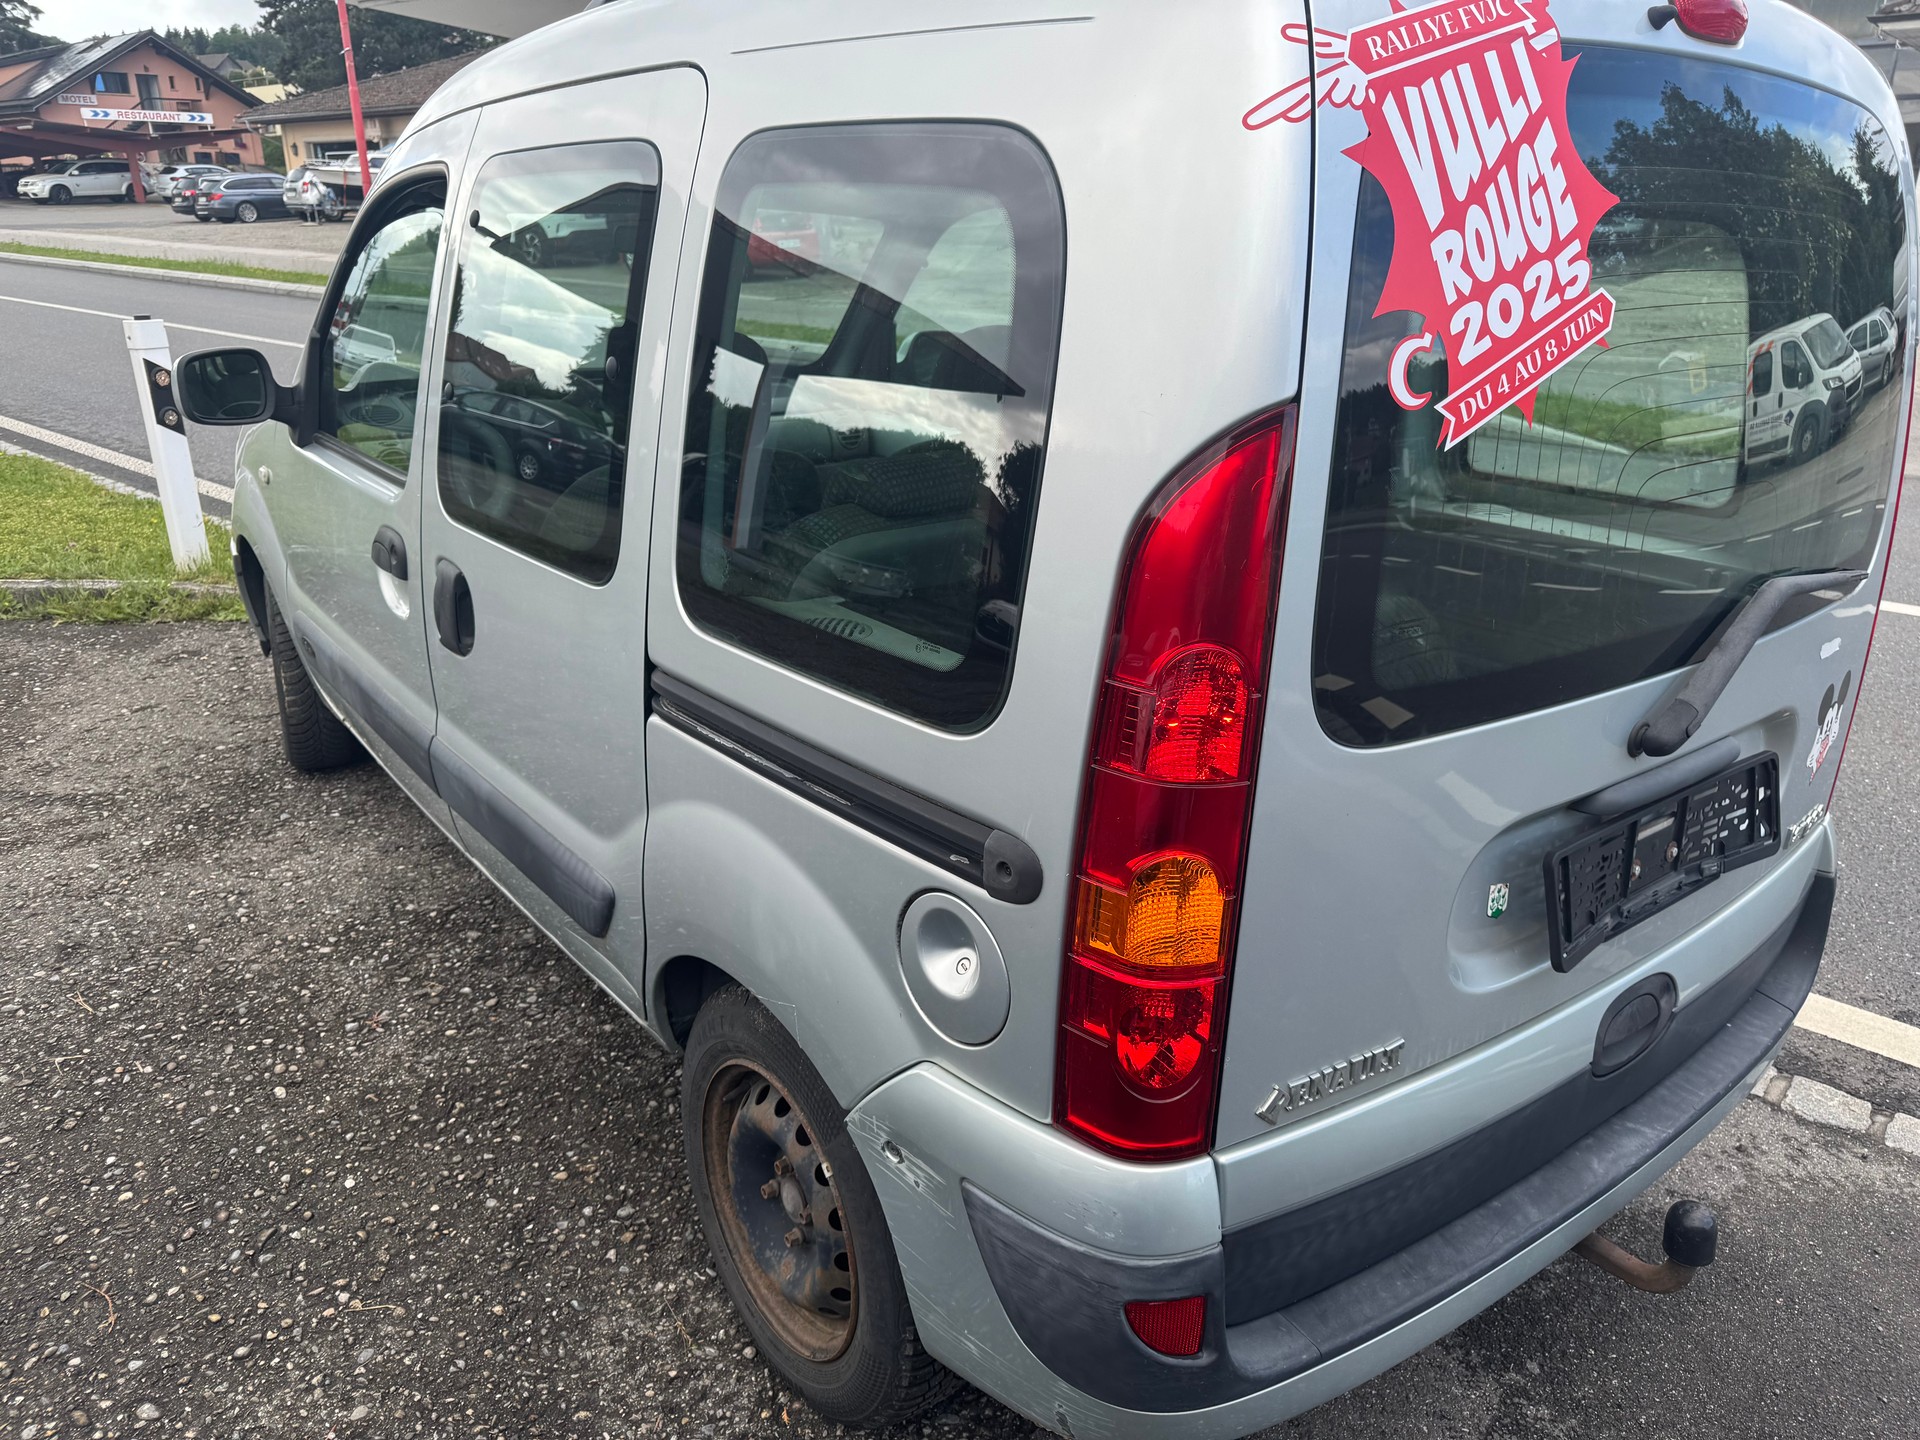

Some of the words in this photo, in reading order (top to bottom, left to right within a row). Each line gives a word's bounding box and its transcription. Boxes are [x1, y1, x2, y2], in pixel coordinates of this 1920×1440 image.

[1365, 11, 1459, 62] RALLYE
[1457, 0, 1513, 30] FVJC
[61, 94, 96, 105] MOTEL
[116, 110, 181, 122] RESTAURANT
[1381, 36, 1543, 233] VULLI
[1430, 116, 1579, 306] ROUGE
[1449, 238, 1590, 367] 2025
[1458, 383, 1494, 424] DU
[1497, 373, 1511, 395] 4
[1514, 347, 1543, 387] AU
[1545, 339, 1559, 362] 8
[1560, 302, 1605, 353] JUIN
